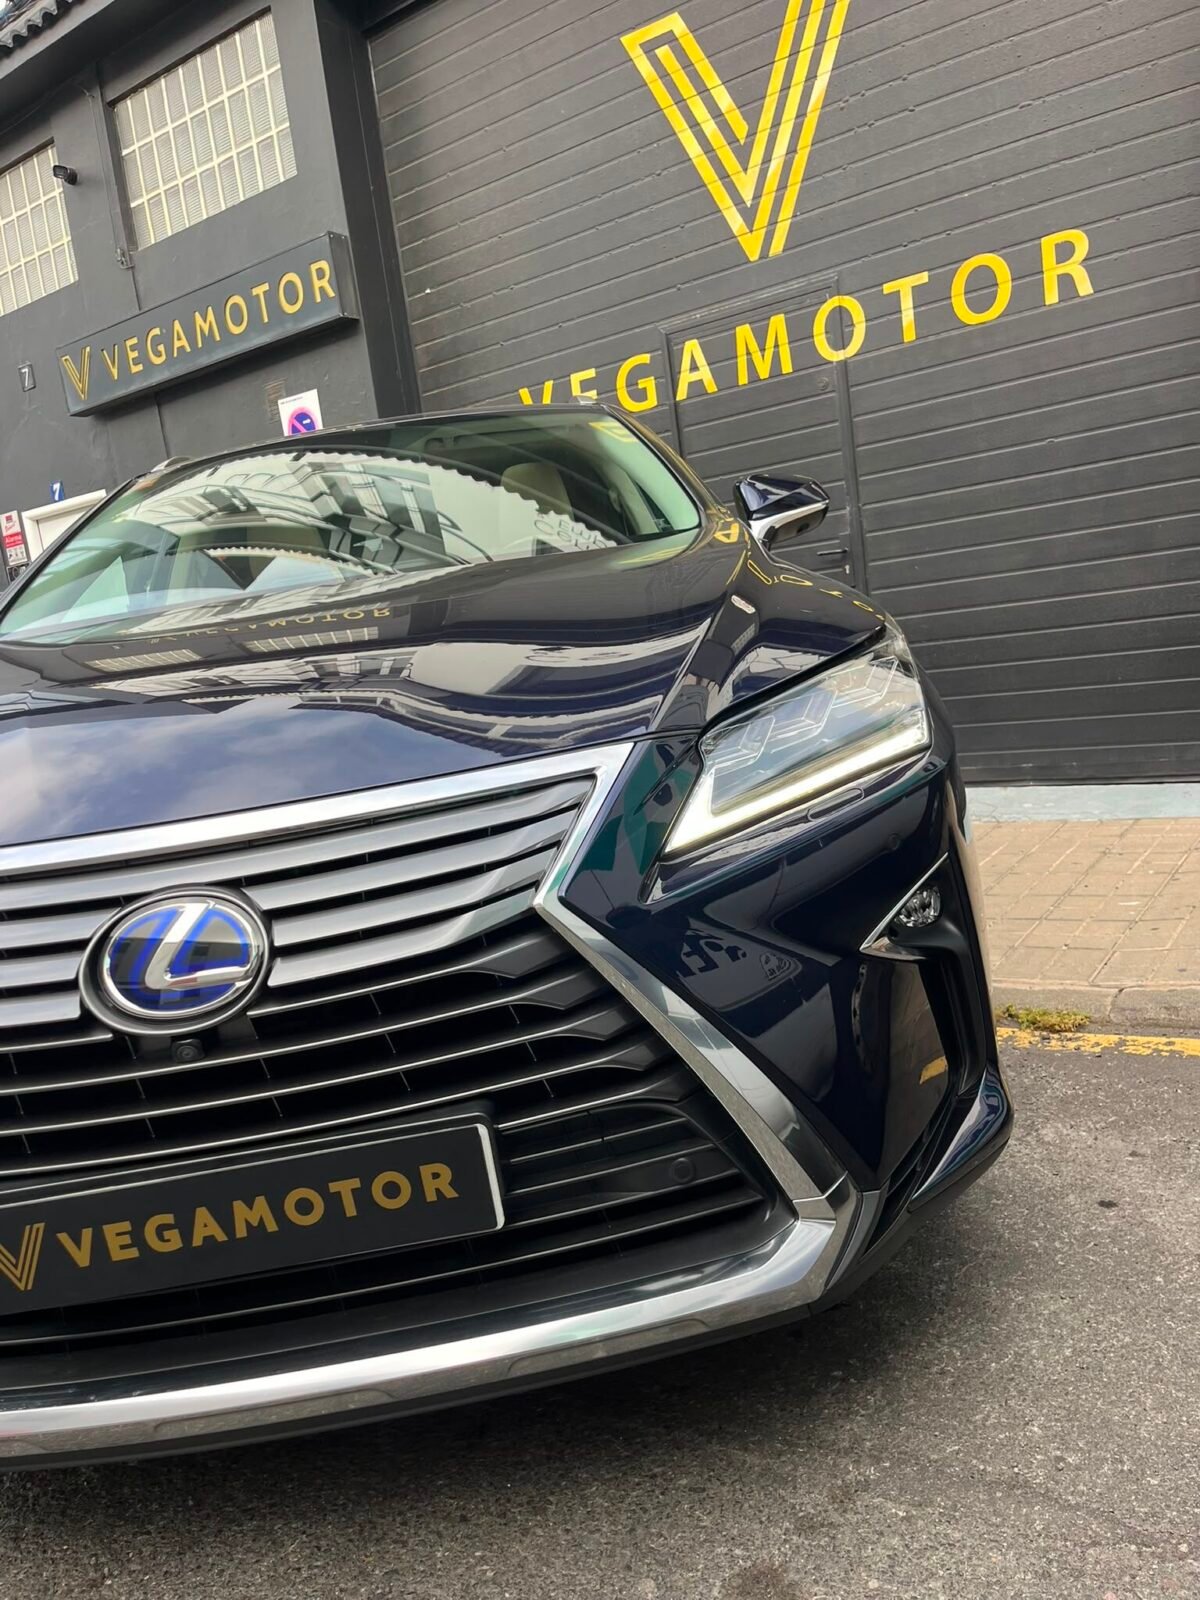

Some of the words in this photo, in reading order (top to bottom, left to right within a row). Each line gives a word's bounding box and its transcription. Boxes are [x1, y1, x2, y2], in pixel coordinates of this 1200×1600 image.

[101, 258, 337, 381] VEGAMOTOR
[20, 366, 29, 388] 7
[55, 1161, 460, 1269] VEGAMOTOR
